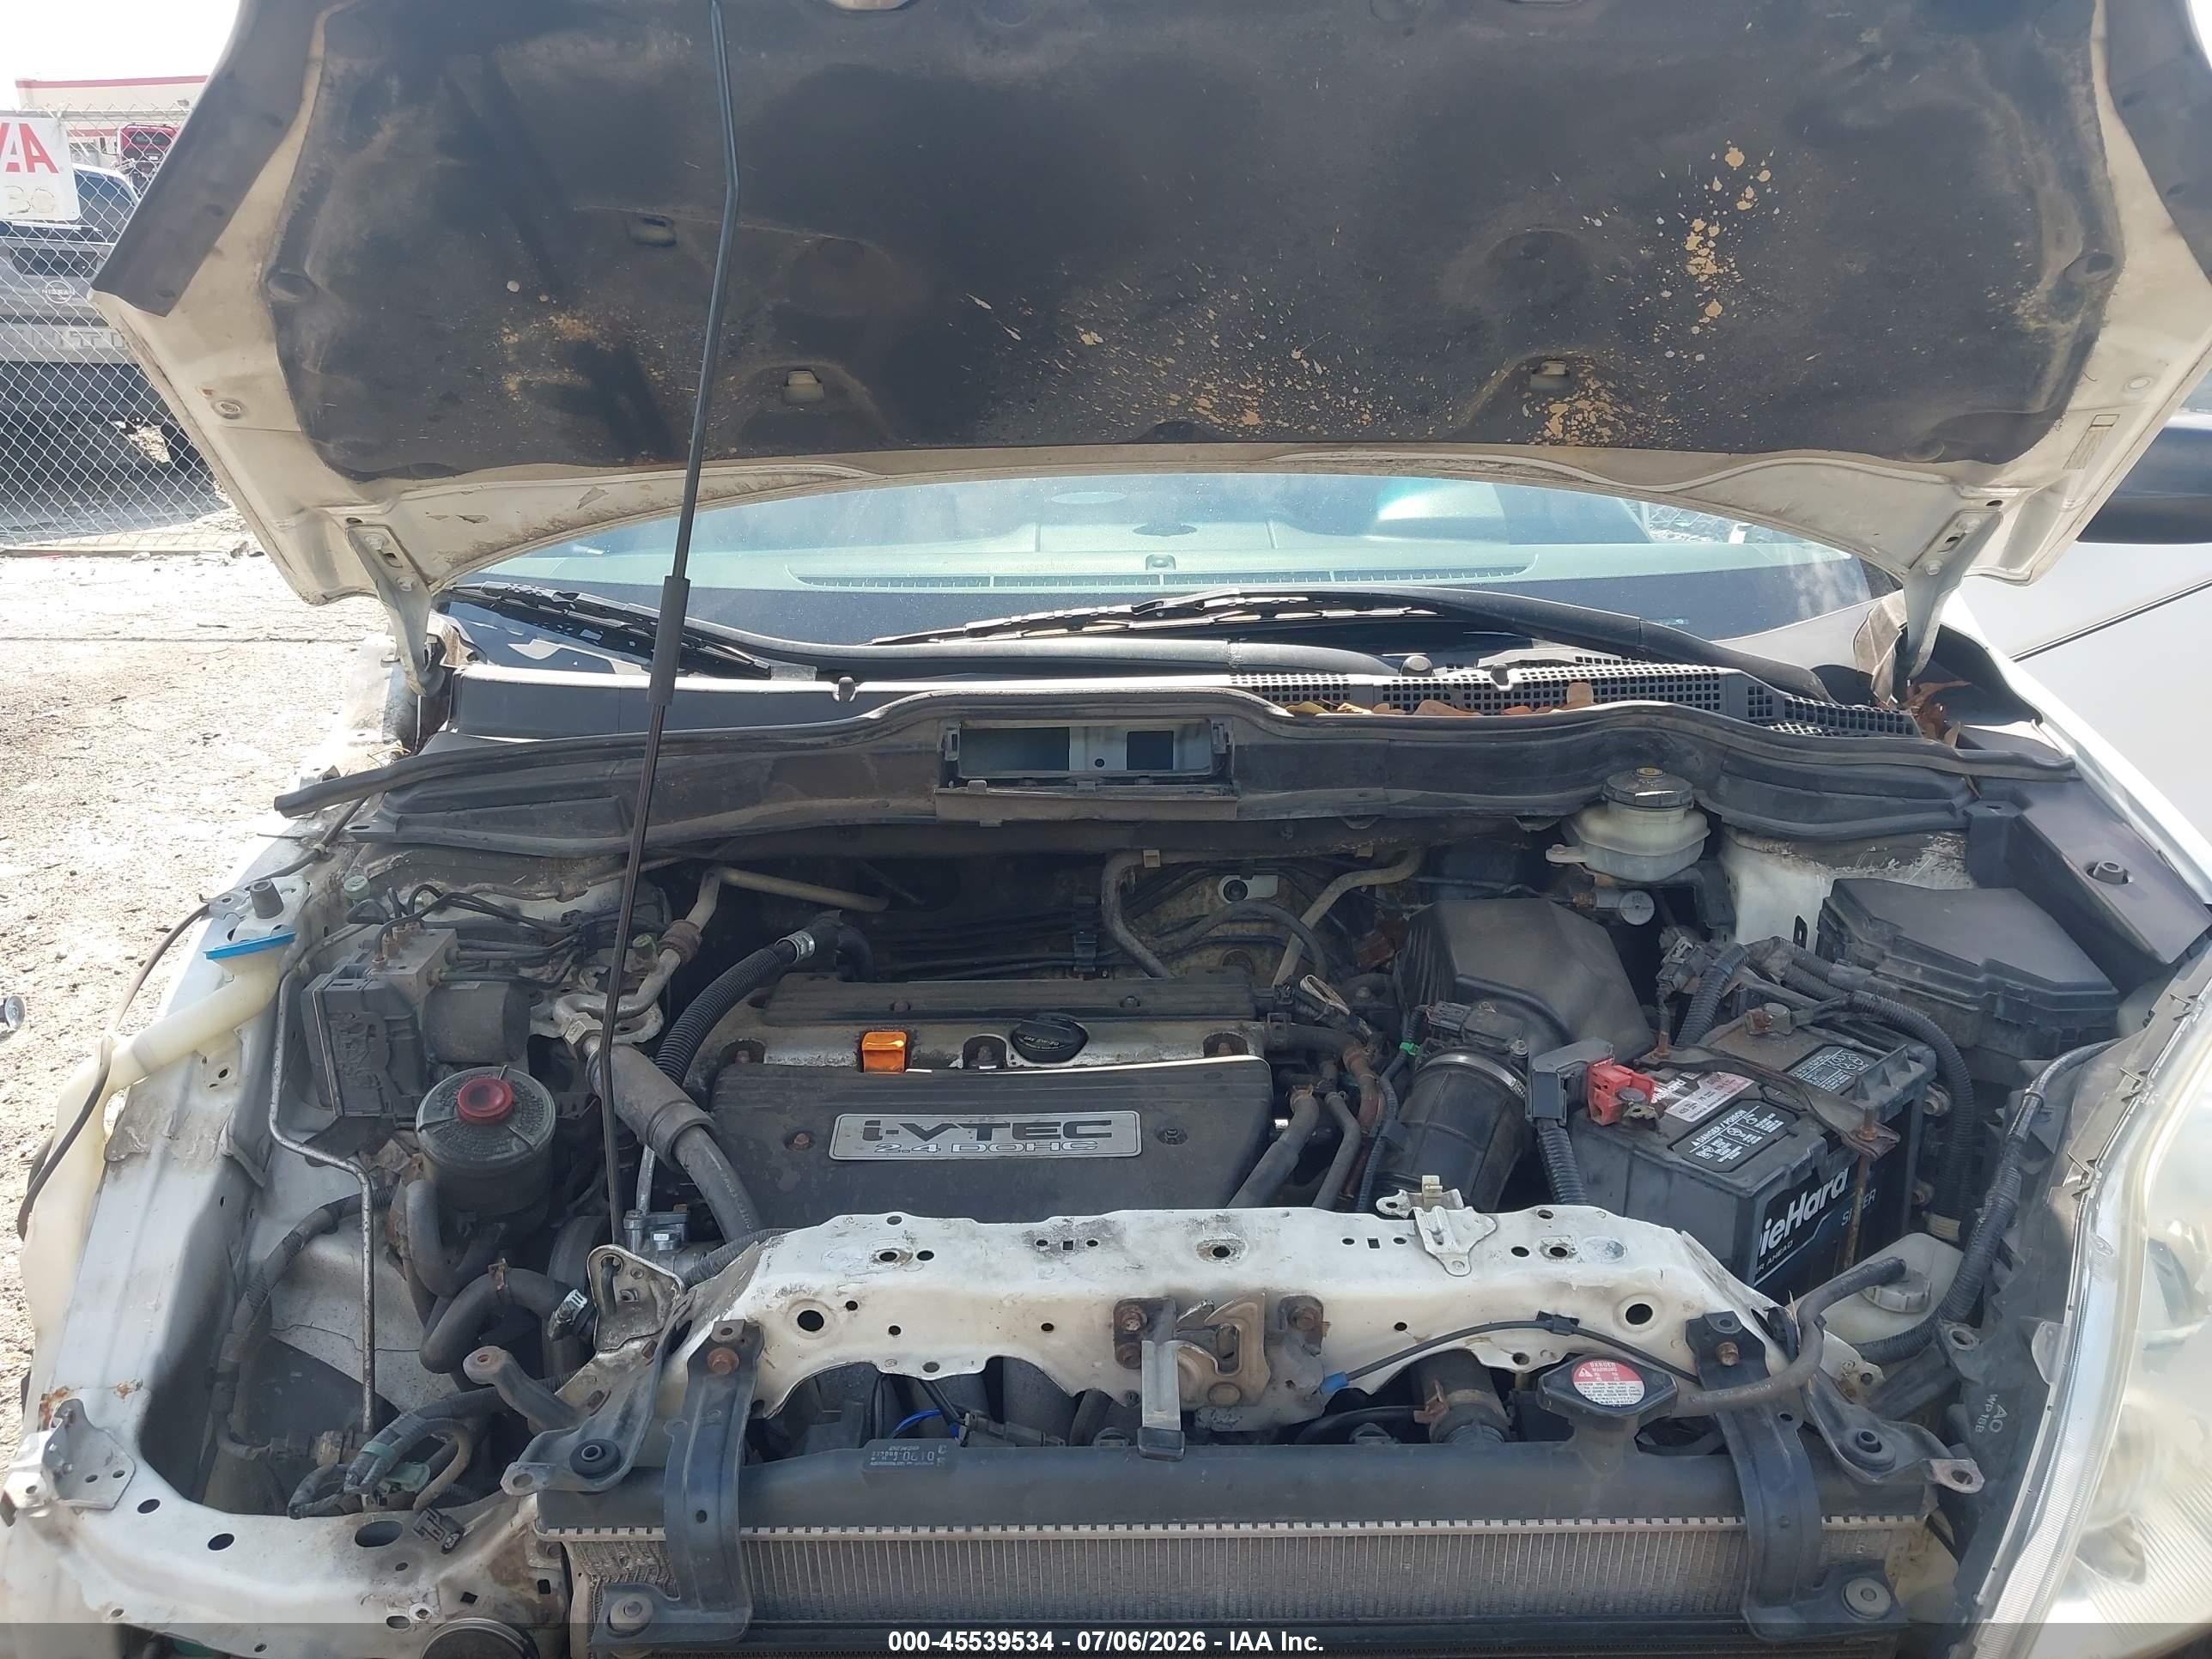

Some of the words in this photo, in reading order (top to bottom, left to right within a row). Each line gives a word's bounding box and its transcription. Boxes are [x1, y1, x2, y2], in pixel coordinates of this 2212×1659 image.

[862, 1119, 1113, 1142] i-VTEC
[1696, 1125, 1723, 1144] DANGER
[1723, 1109, 1748, 1126] POISON
[874, 1143, 941, 1153] 2.4
[951, 1141, 1099, 1153] DOHC
[1759, 1166, 1850, 1258] ieHard
[1766, 1239, 1795, 1267] AHEAD
